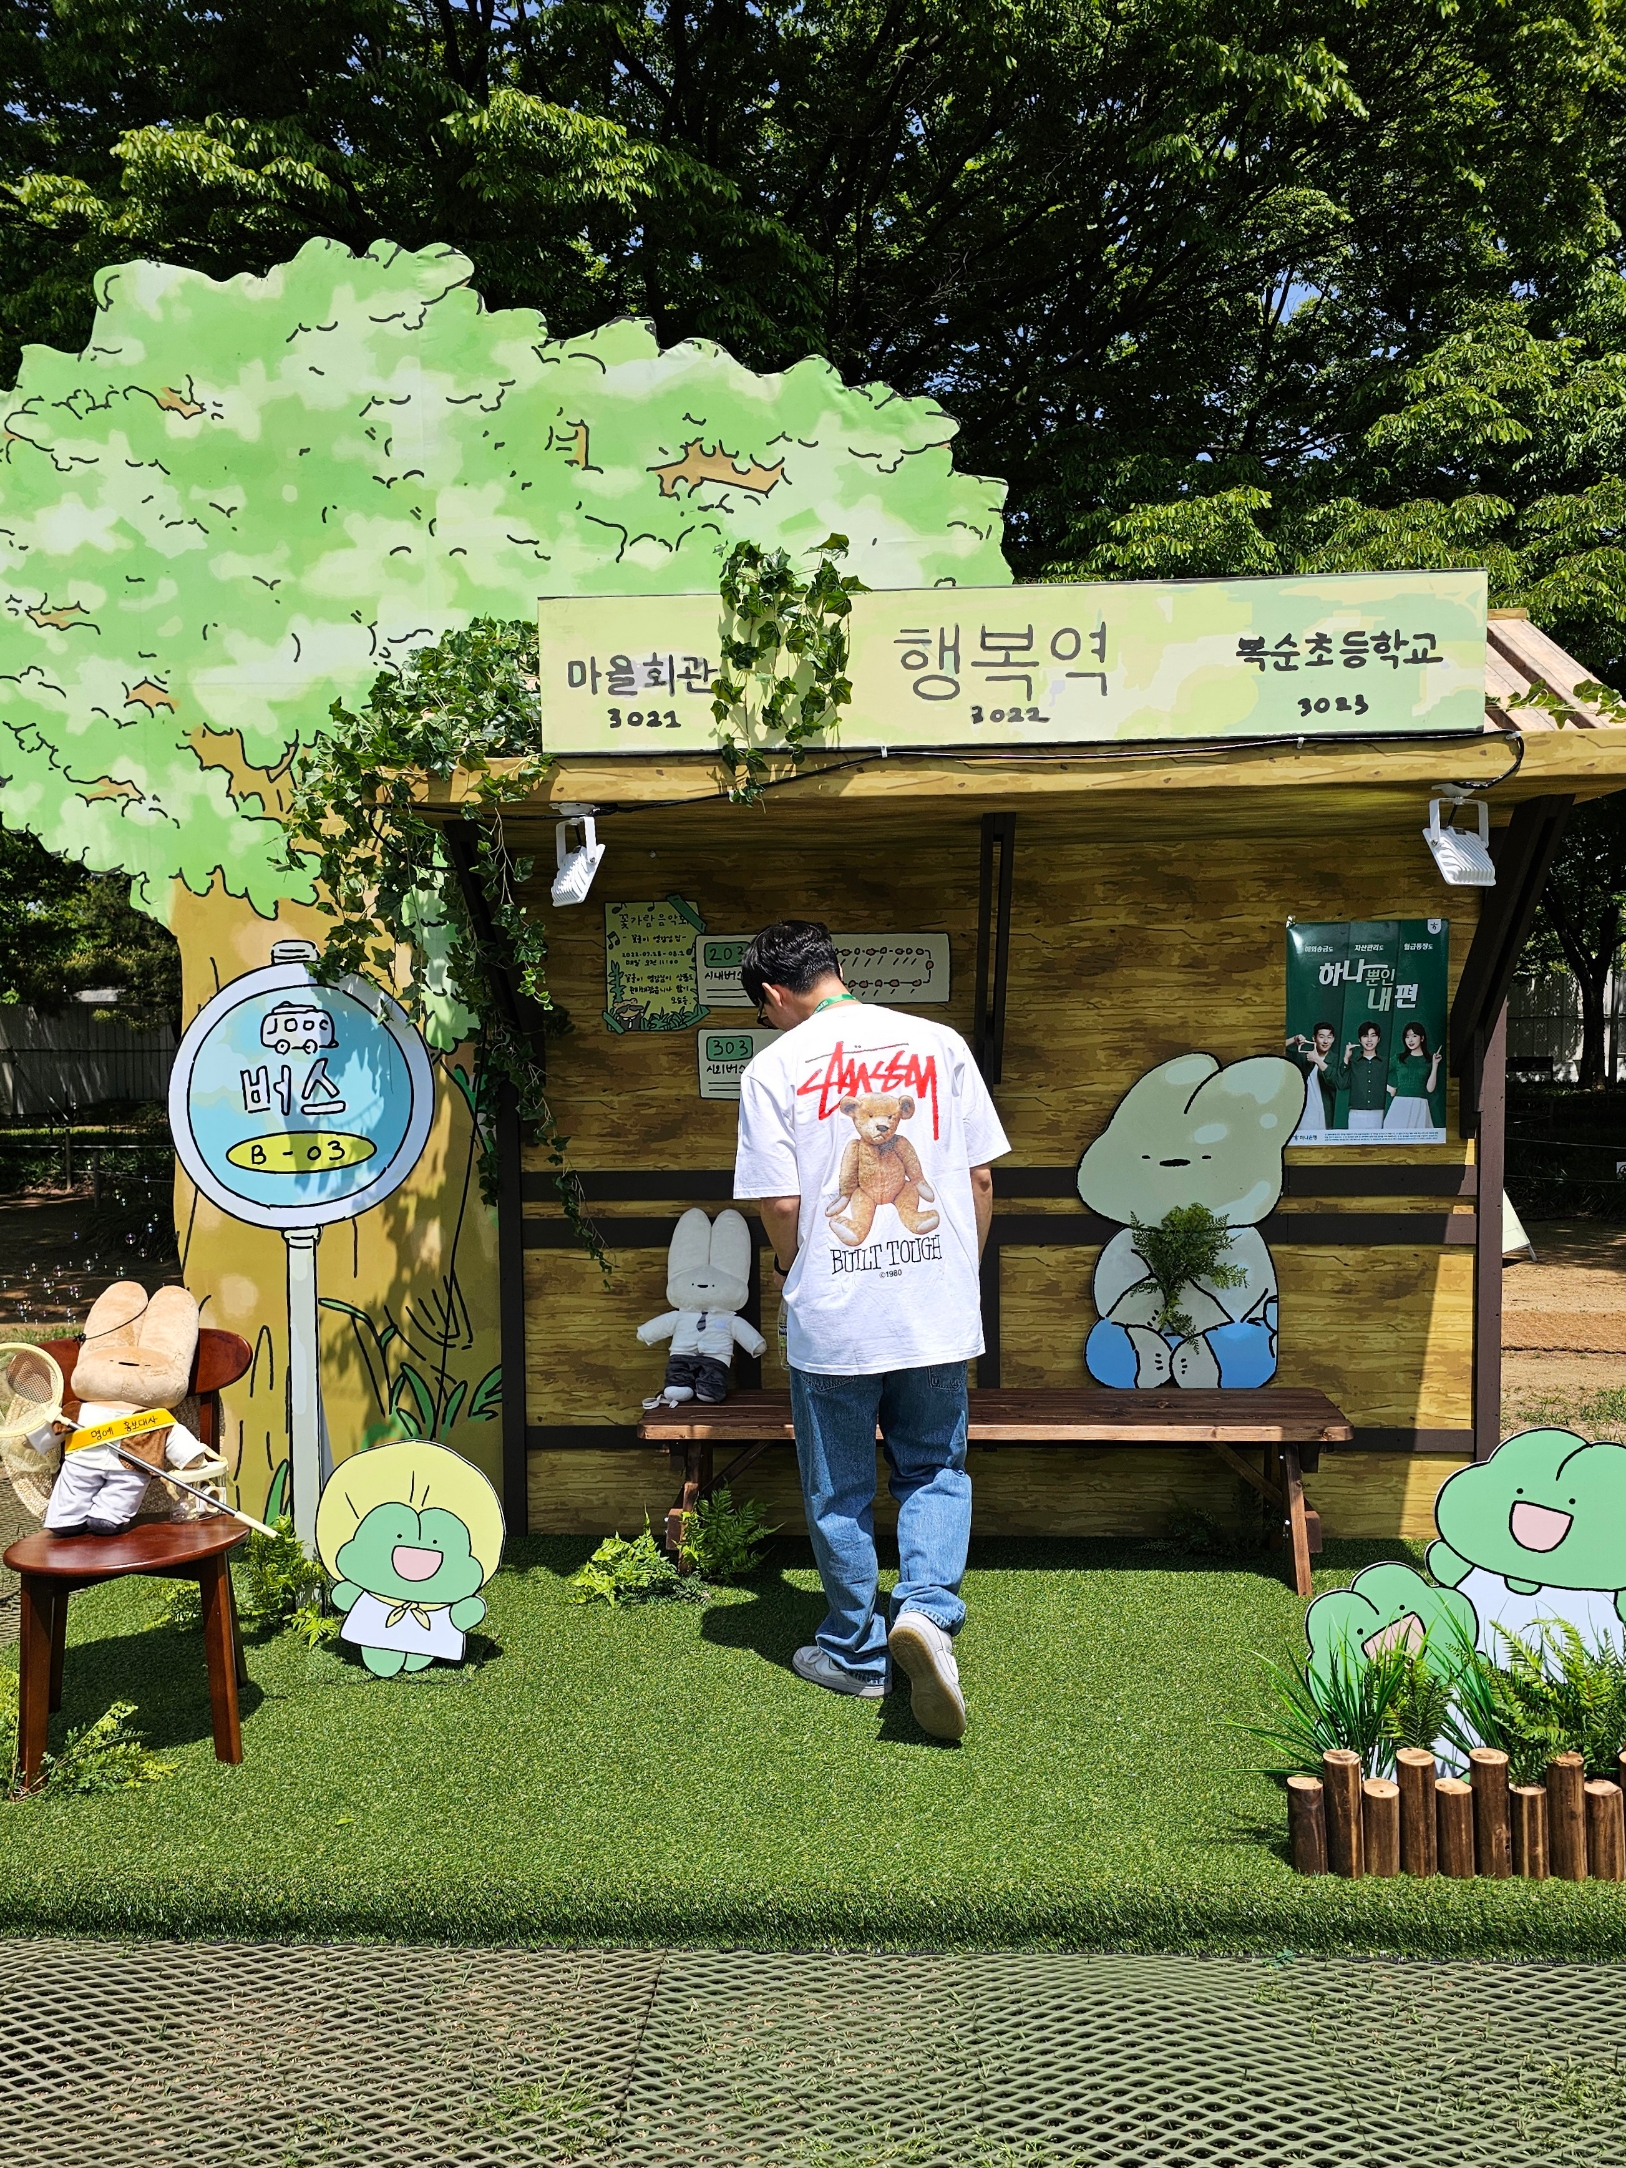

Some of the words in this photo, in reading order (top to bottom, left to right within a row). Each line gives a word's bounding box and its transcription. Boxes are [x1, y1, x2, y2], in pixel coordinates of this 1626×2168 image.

[893, 621, 1108, 702] 행복역
[567, 652, 721, 697] 마을회관
[970, 704, 1051, 725] 3022
[1297, 694, 1369, 717] 3023
[607, 707, 682, 729] 3021
[713, 1039, 749, 1056] 303
[240, 1057, 346, 1117] 버스
[829, 1246, 884, 1276] BUILT
[887, 1233, 943, 1266] TOUGH
[123, 1416, 158, 1432] 홍보대사
